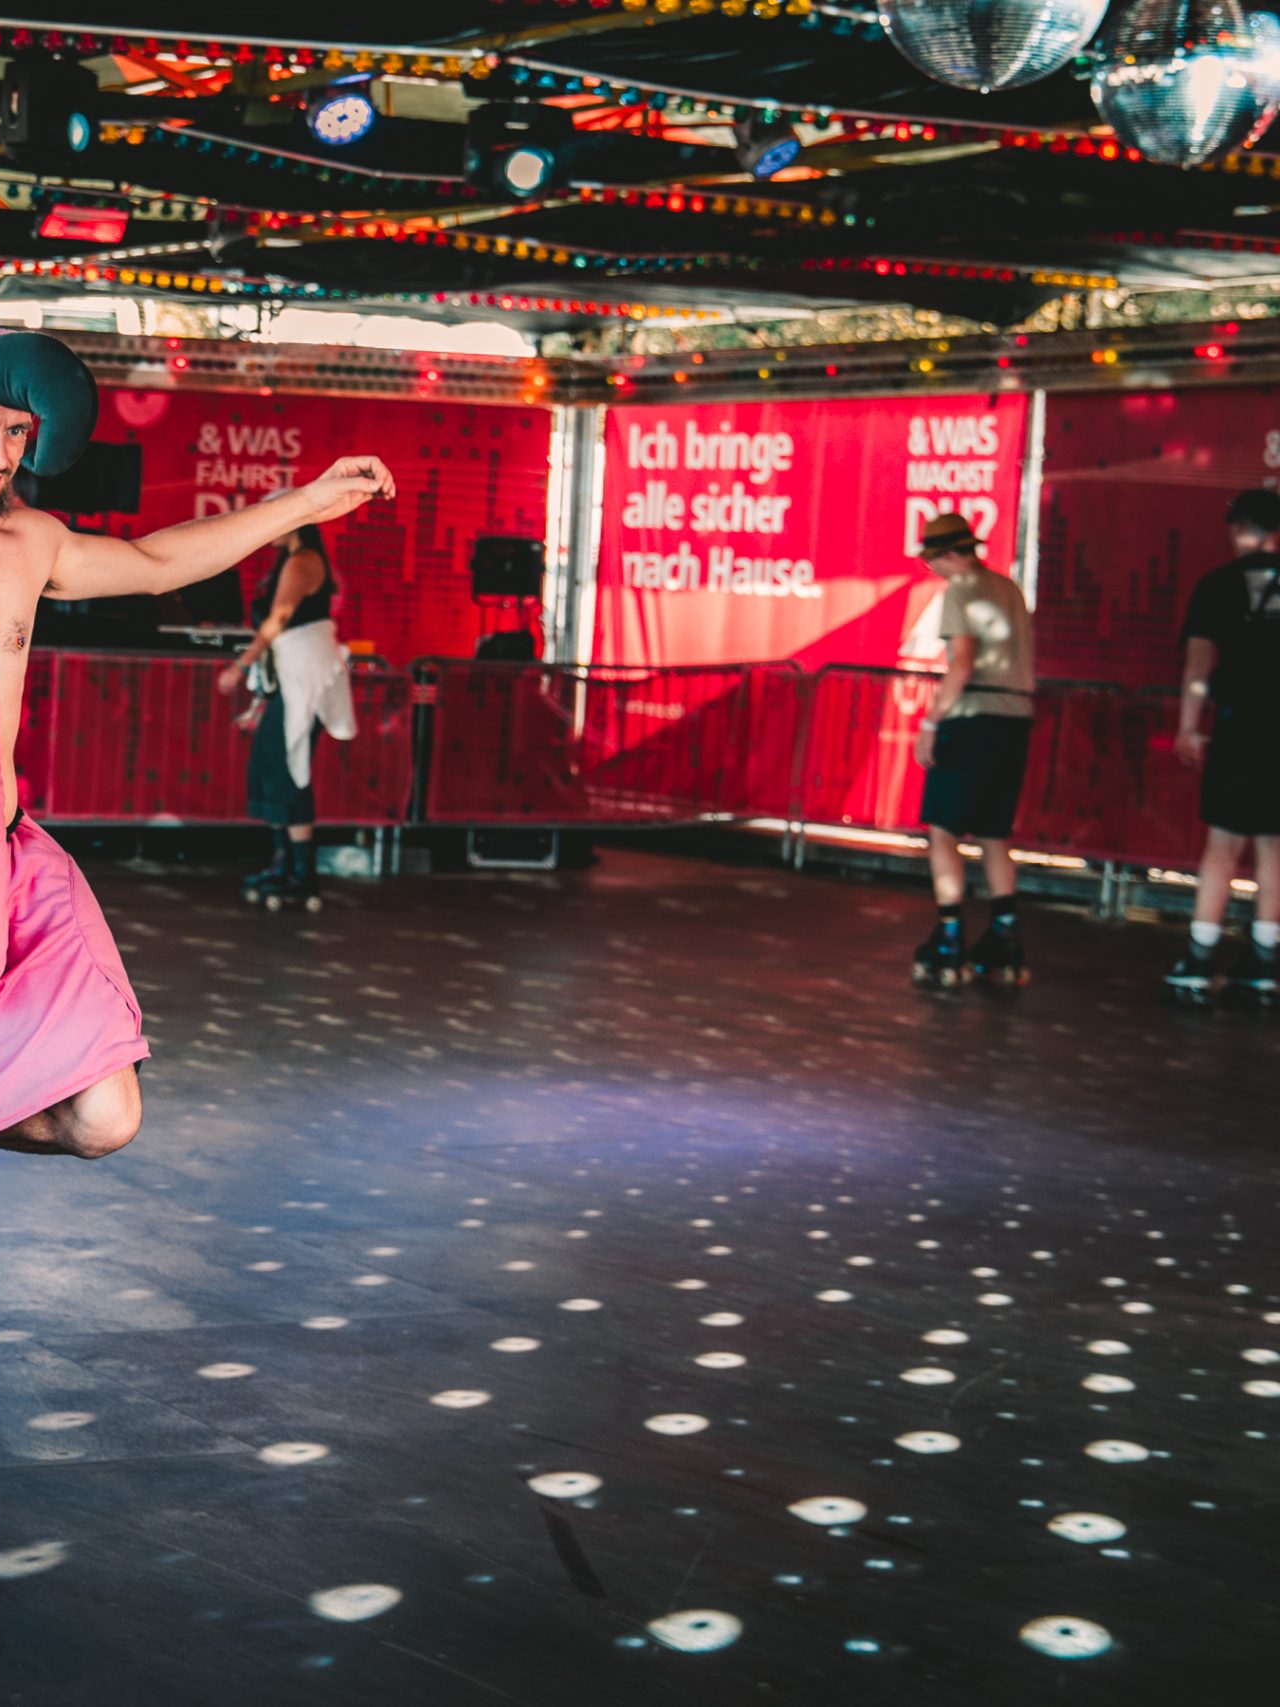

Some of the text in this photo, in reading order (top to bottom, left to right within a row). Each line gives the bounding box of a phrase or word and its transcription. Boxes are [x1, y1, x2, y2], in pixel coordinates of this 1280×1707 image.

[198, 422, 302, 459] & WAS
[628, 420, 794, 484] Ich bringe
[907, 415, 999, 456] & WAS
[906, 460, 999, 493] MACHST
[622, 479, 792, 534] alle sicher
[903, 496, 999, 560] D?
[622, 541, 824, 599] nach Hause.
